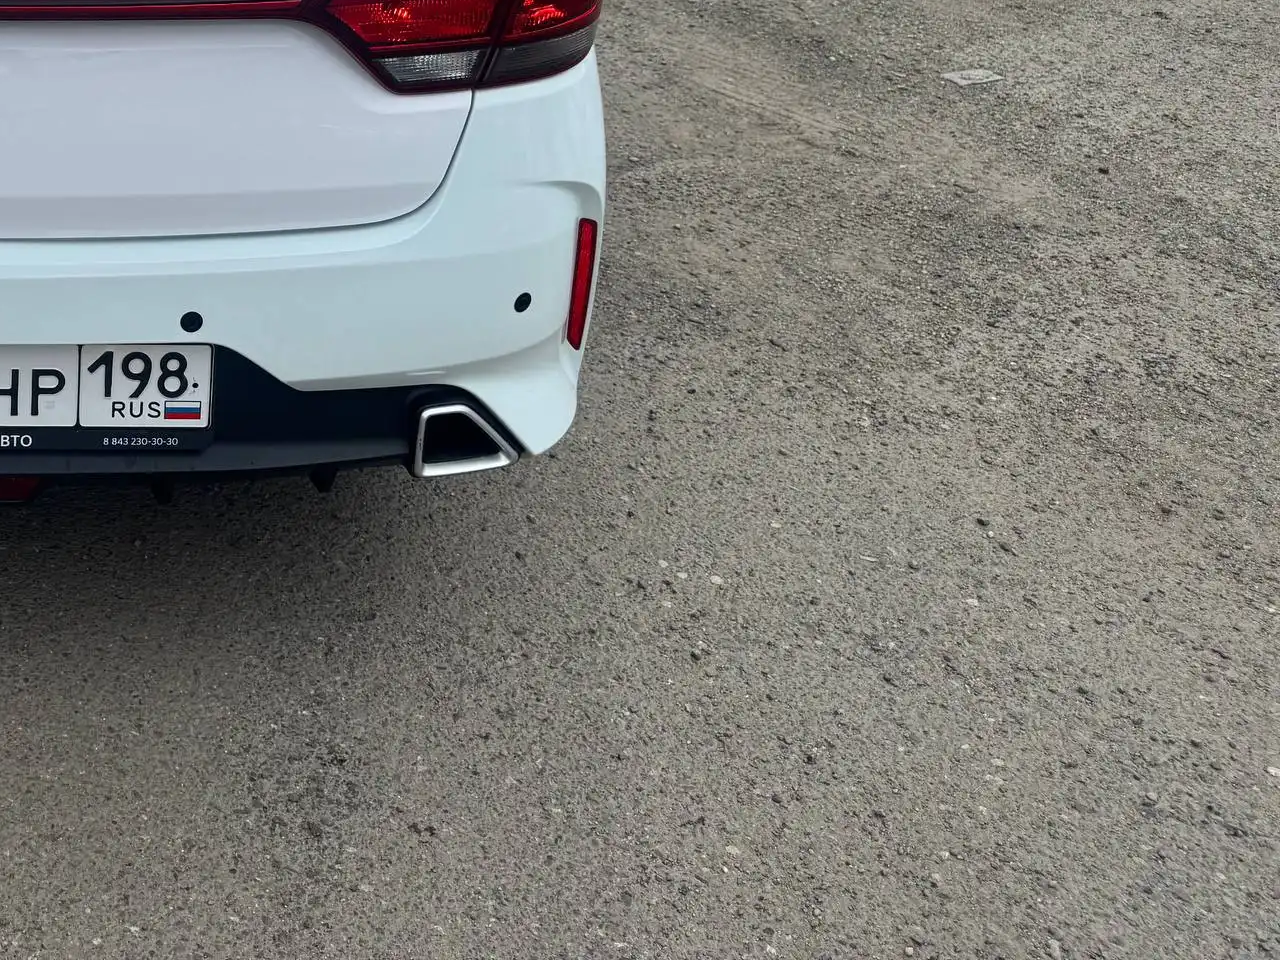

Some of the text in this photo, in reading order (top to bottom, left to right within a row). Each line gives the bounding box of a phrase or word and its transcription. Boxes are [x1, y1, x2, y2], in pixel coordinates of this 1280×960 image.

[87, 350, 188, 399] 198
[111, 401, 162, 419] RUS
[103, 437, 179, 446] 8 843 230-30-30
